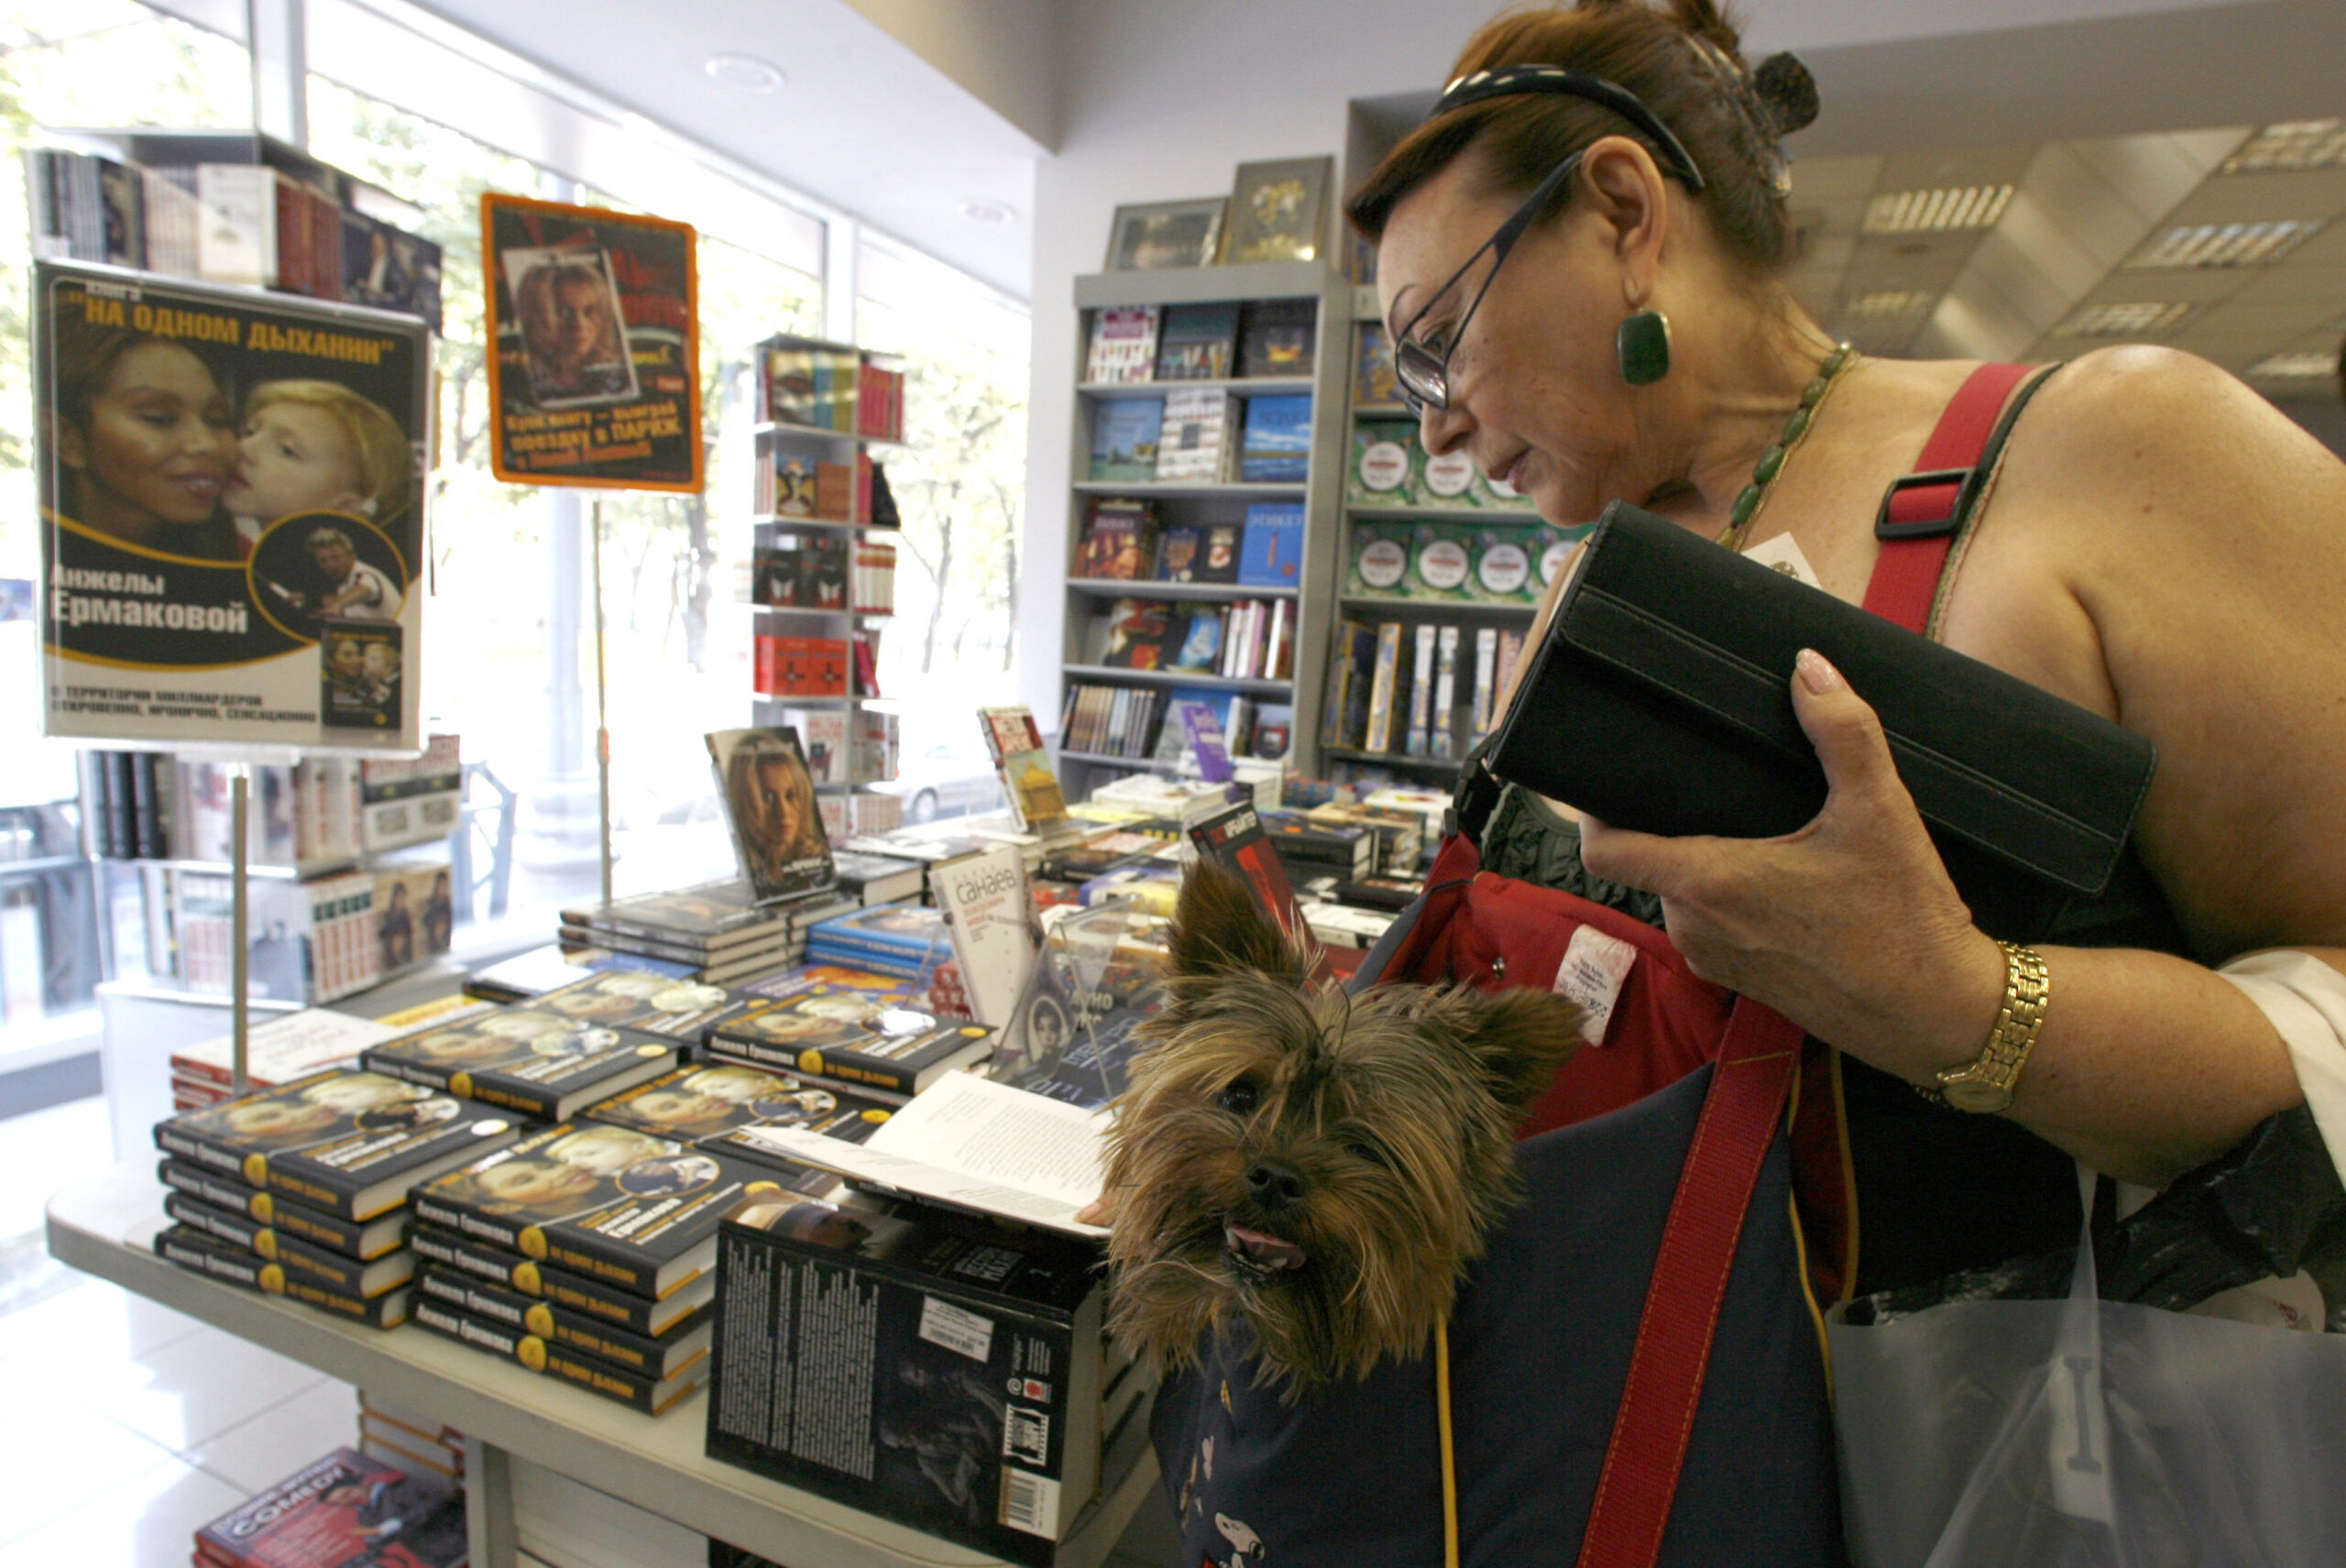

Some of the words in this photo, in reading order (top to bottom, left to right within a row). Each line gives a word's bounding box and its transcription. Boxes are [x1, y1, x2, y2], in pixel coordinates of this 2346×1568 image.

[133, 304, 239, 345] ОДНОМ
[247, 321, 395, 365] ДЫХАНИИ"
[611, 418, 681, 441] ПАРИЖ
[49, 562, 166, 595] Анжелы
[49, 589, 248, 634] Ермаковой
